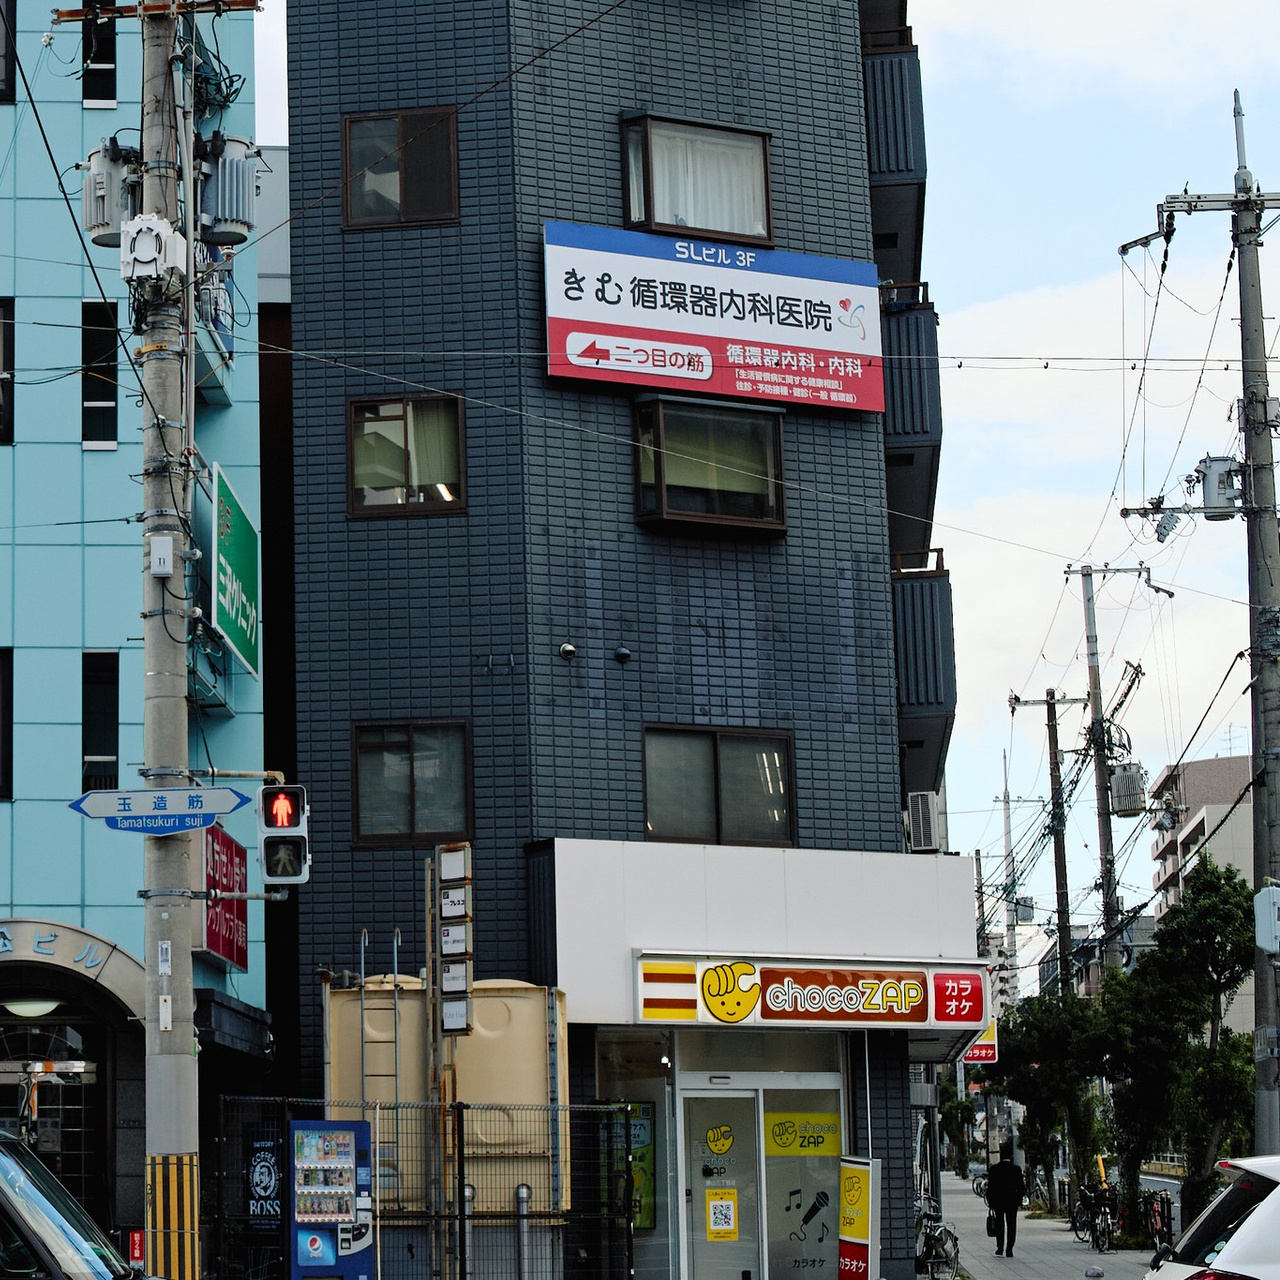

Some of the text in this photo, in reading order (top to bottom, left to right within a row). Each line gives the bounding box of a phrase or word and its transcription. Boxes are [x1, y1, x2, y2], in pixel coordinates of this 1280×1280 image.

[675, 241, 756, 268] SLビル 3F
[614, 345, 704, 373] 二つ目の筋
[726, 343, 863, 378] 循環器内科・内科
[116, 794, 204, 812] 玉造筋
[115, 814, 204, 829] Tamatsukuri suji
[945, 978, 973, 996] カラ
[767, 979, 924, 1013] chocoZAP
[945, 999, 973, 1016] オケ
[798, 1121, 838, 1134] choco
[798, 1135, 825, 1148] ZAP
[251, 1151, 276, 1166] COFFEE
[249, 1200, 280, 1215] BOSS
[842, 1215, 855, 1227] ZAP
[792, 1258, 826, 1269] カラオケ
[839, 1256, 867, 1273] カラオケ
